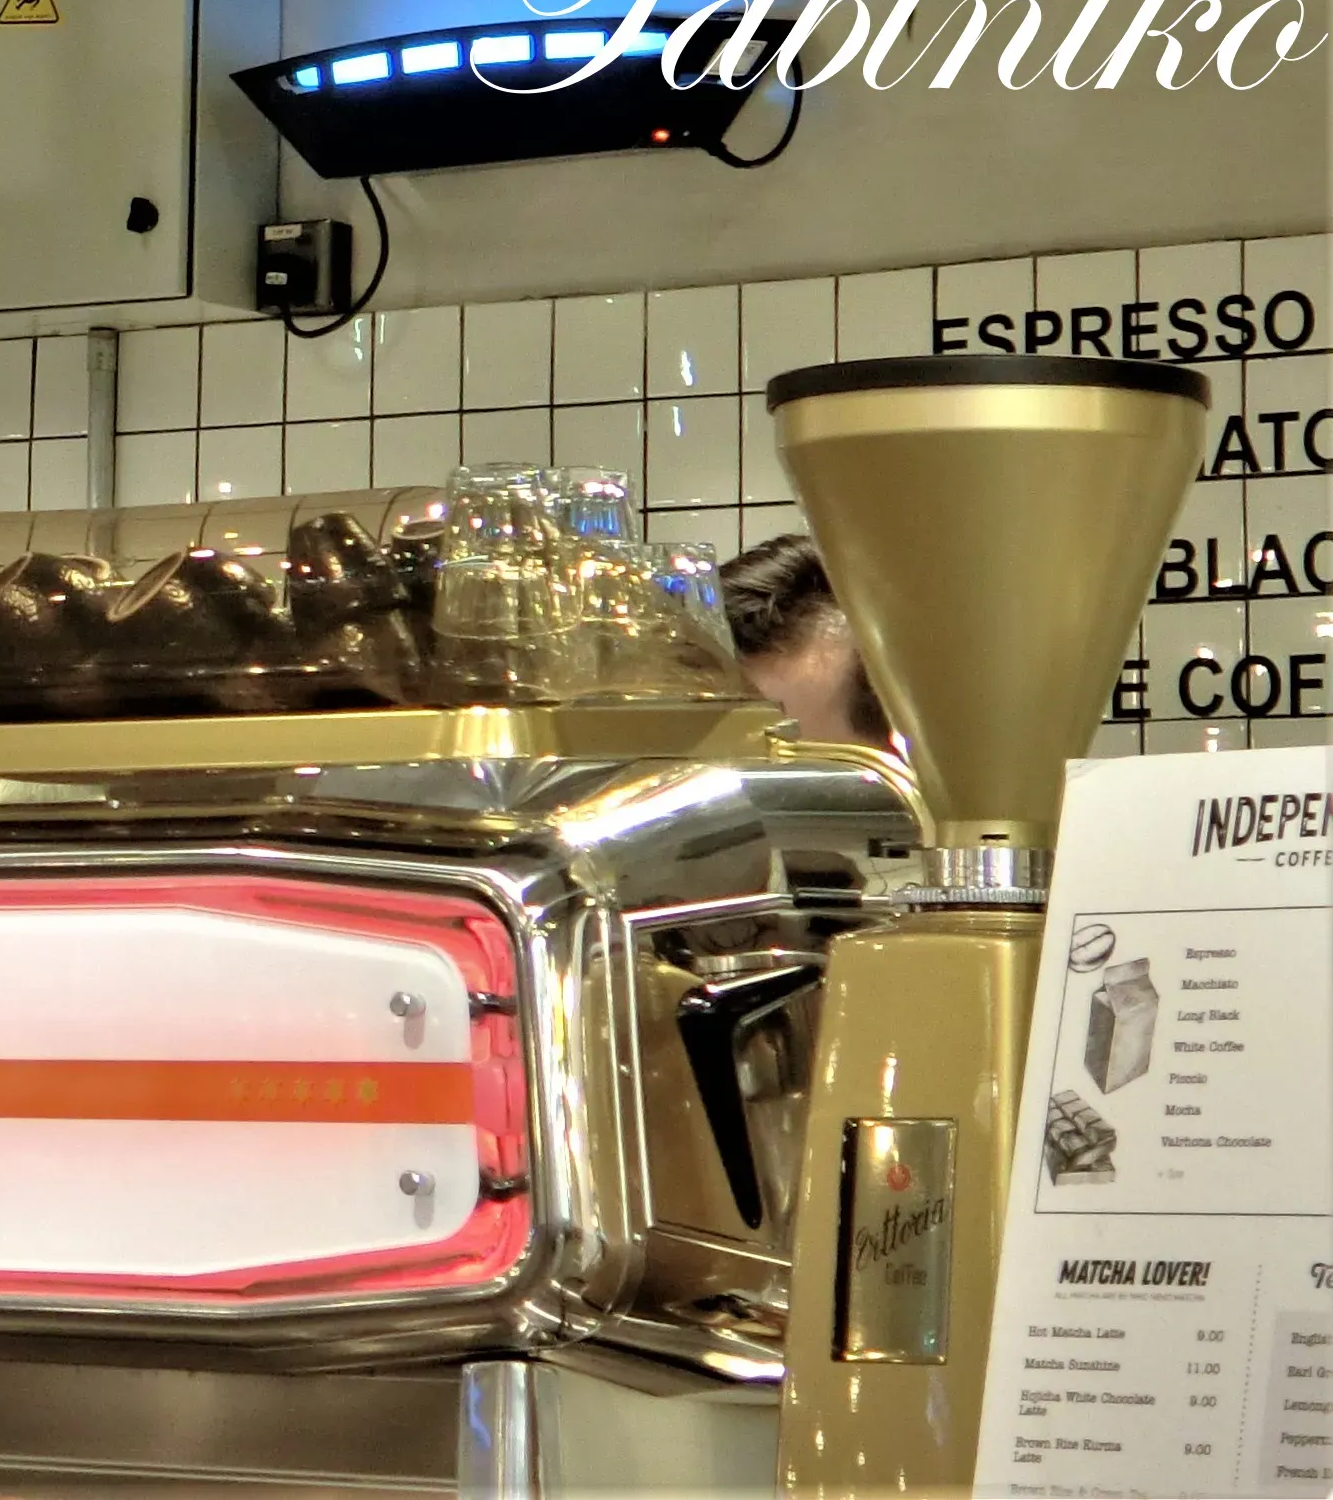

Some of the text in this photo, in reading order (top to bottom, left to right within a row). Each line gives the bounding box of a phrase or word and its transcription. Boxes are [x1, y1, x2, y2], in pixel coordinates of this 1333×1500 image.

[934, 290, 1315, 360] ESPRESSO
[1178, 654, 1326, 717] COF
[1185, 948, 1237, 962] Espresso
[1181, 979, 1239, 991] Macchiato
[1177, 1010, 1240, 1024] Long Black
[1173, 1041, 1245, 1052] White Coffee
[1165, 1104, 1201, 1116] Mocha
[1216, 1136, 1272, 1148] Chocolate
[1058, 1260, 1212, 1287] MATCHA LOVER!
[1028, 1326, 1225, 1342] Hot Matcha Latte 9.00
[1024, 1358, 1221, 1375] Matcha Sunshine 11.00
[1066, 1392, 1097, 1404] White
[1101, 1392, 1156, 1405] Chocolate
[1018, 1405, 1047, 1417] Latte
[1015, 1436, 1051, 1449] Brown
[1184, 1443, 1212, 1455] 9.00
